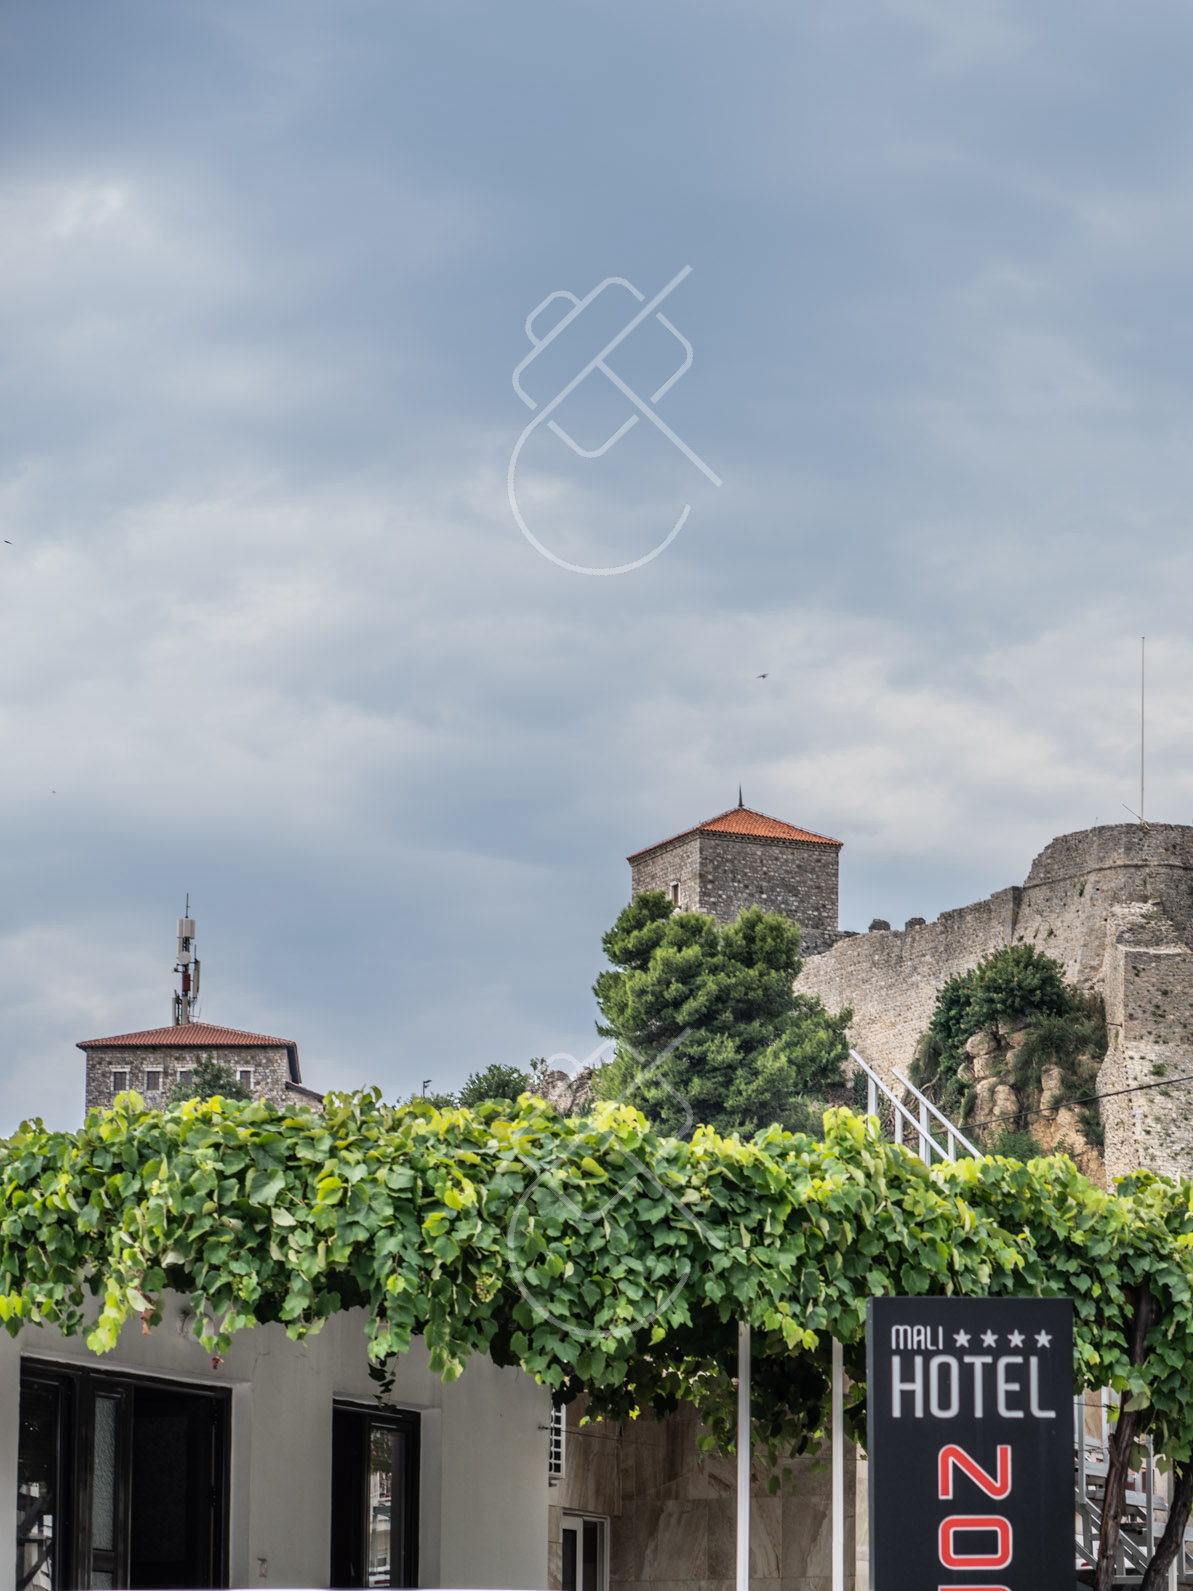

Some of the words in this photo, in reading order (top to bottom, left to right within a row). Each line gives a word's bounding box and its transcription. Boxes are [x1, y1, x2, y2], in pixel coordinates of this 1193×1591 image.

[891, 1325, 944, 1350] MALI
[891, 1355, 1056, 1418] HOTEL
[938, 1444, 1014, 1591] NO
